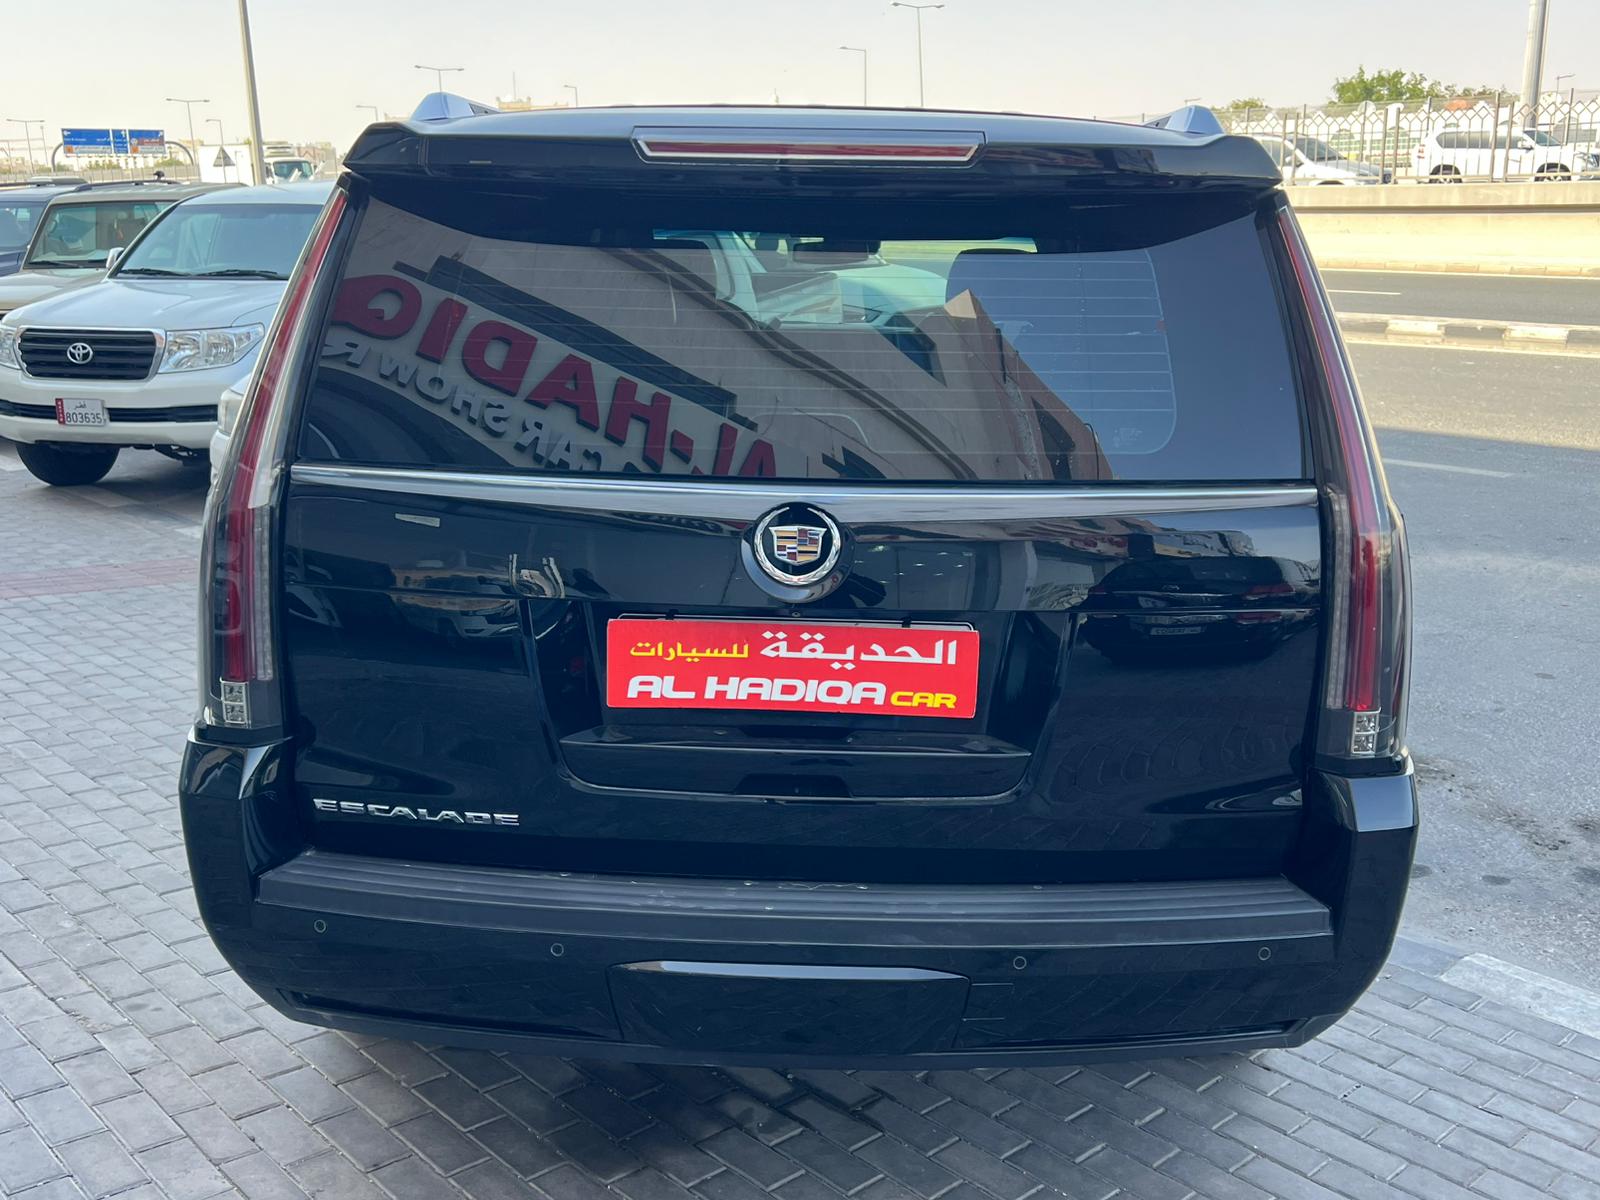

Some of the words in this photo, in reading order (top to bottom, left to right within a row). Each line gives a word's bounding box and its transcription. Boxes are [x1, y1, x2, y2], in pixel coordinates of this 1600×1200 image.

[65, 411, 103, 424] 803635
[629, 640, 750, 663] للسيارات
[759, 630, 957, 671] الحديقة
[626, 674, 696, 700] AL
[703, 676, 887, 706] HADIQA
[890, 690, 958, 709] CAR
[312, 798, 521, 826] ESCALADE
